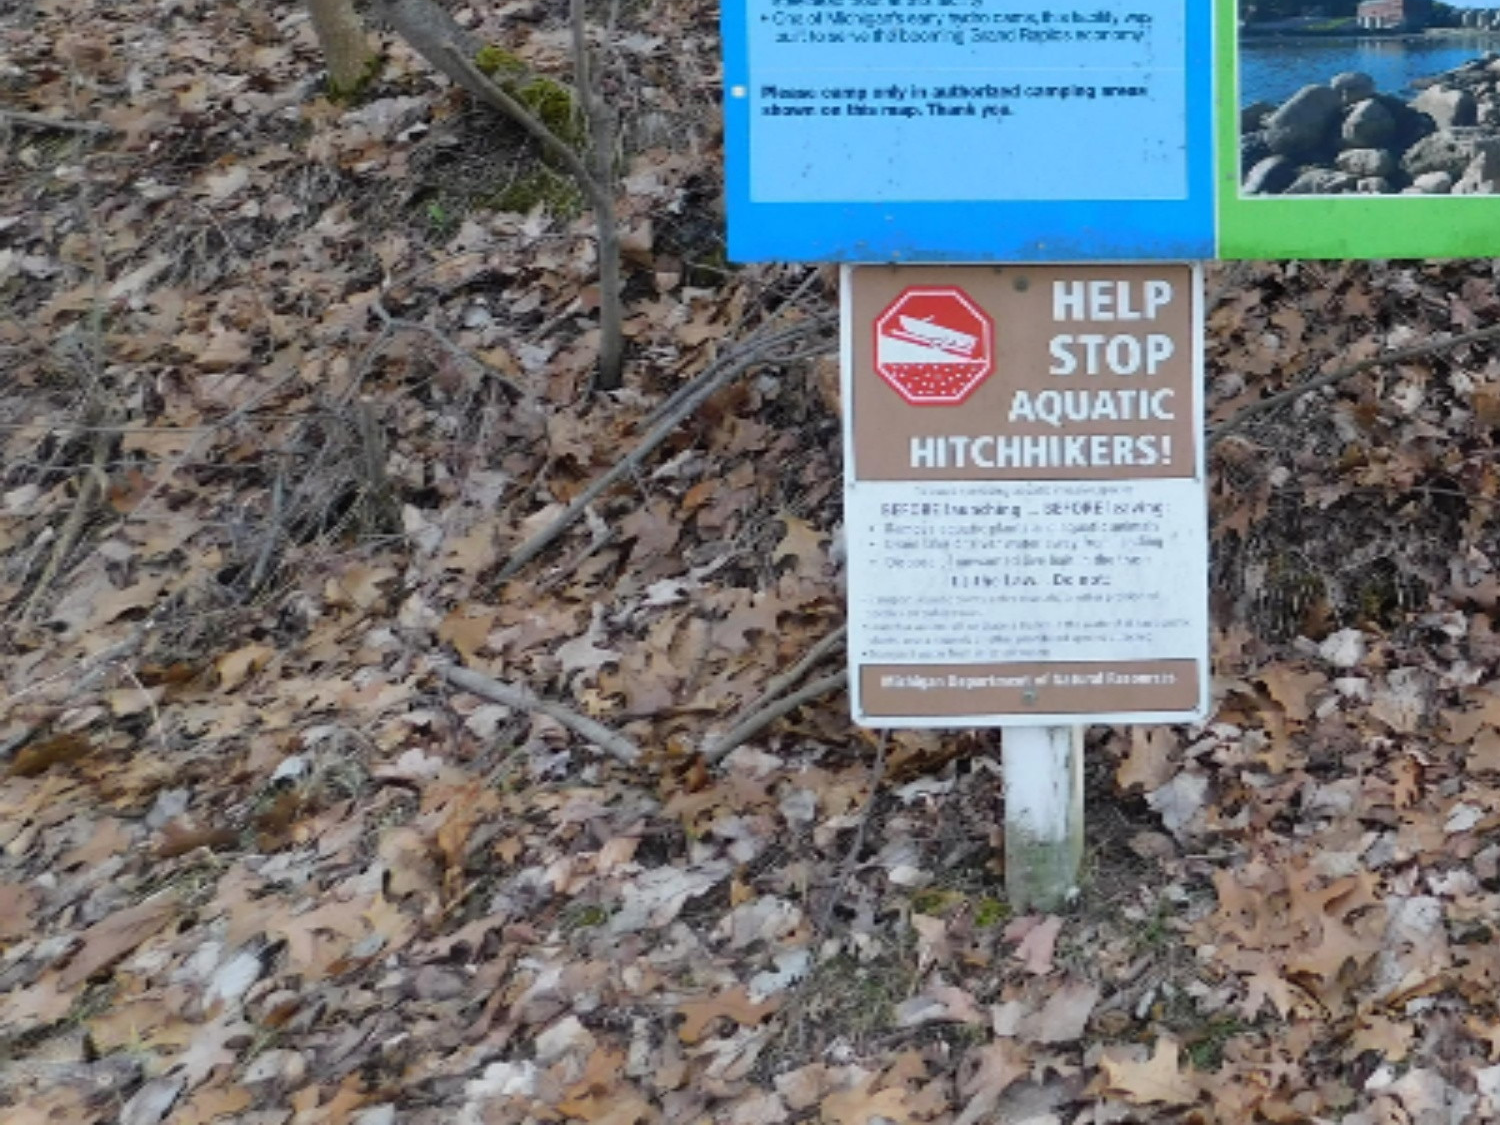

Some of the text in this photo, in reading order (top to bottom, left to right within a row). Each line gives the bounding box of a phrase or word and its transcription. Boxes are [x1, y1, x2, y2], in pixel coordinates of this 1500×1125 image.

[927, 103, 975, 117] Thank
[1053, 280, 1174, 321] HELP
[1049, 333, 1175, 375] STOP
[1007, 388, 1176, 427] AQUATIC
[909, 434, 1171, 468] HITCHHIKERS!
